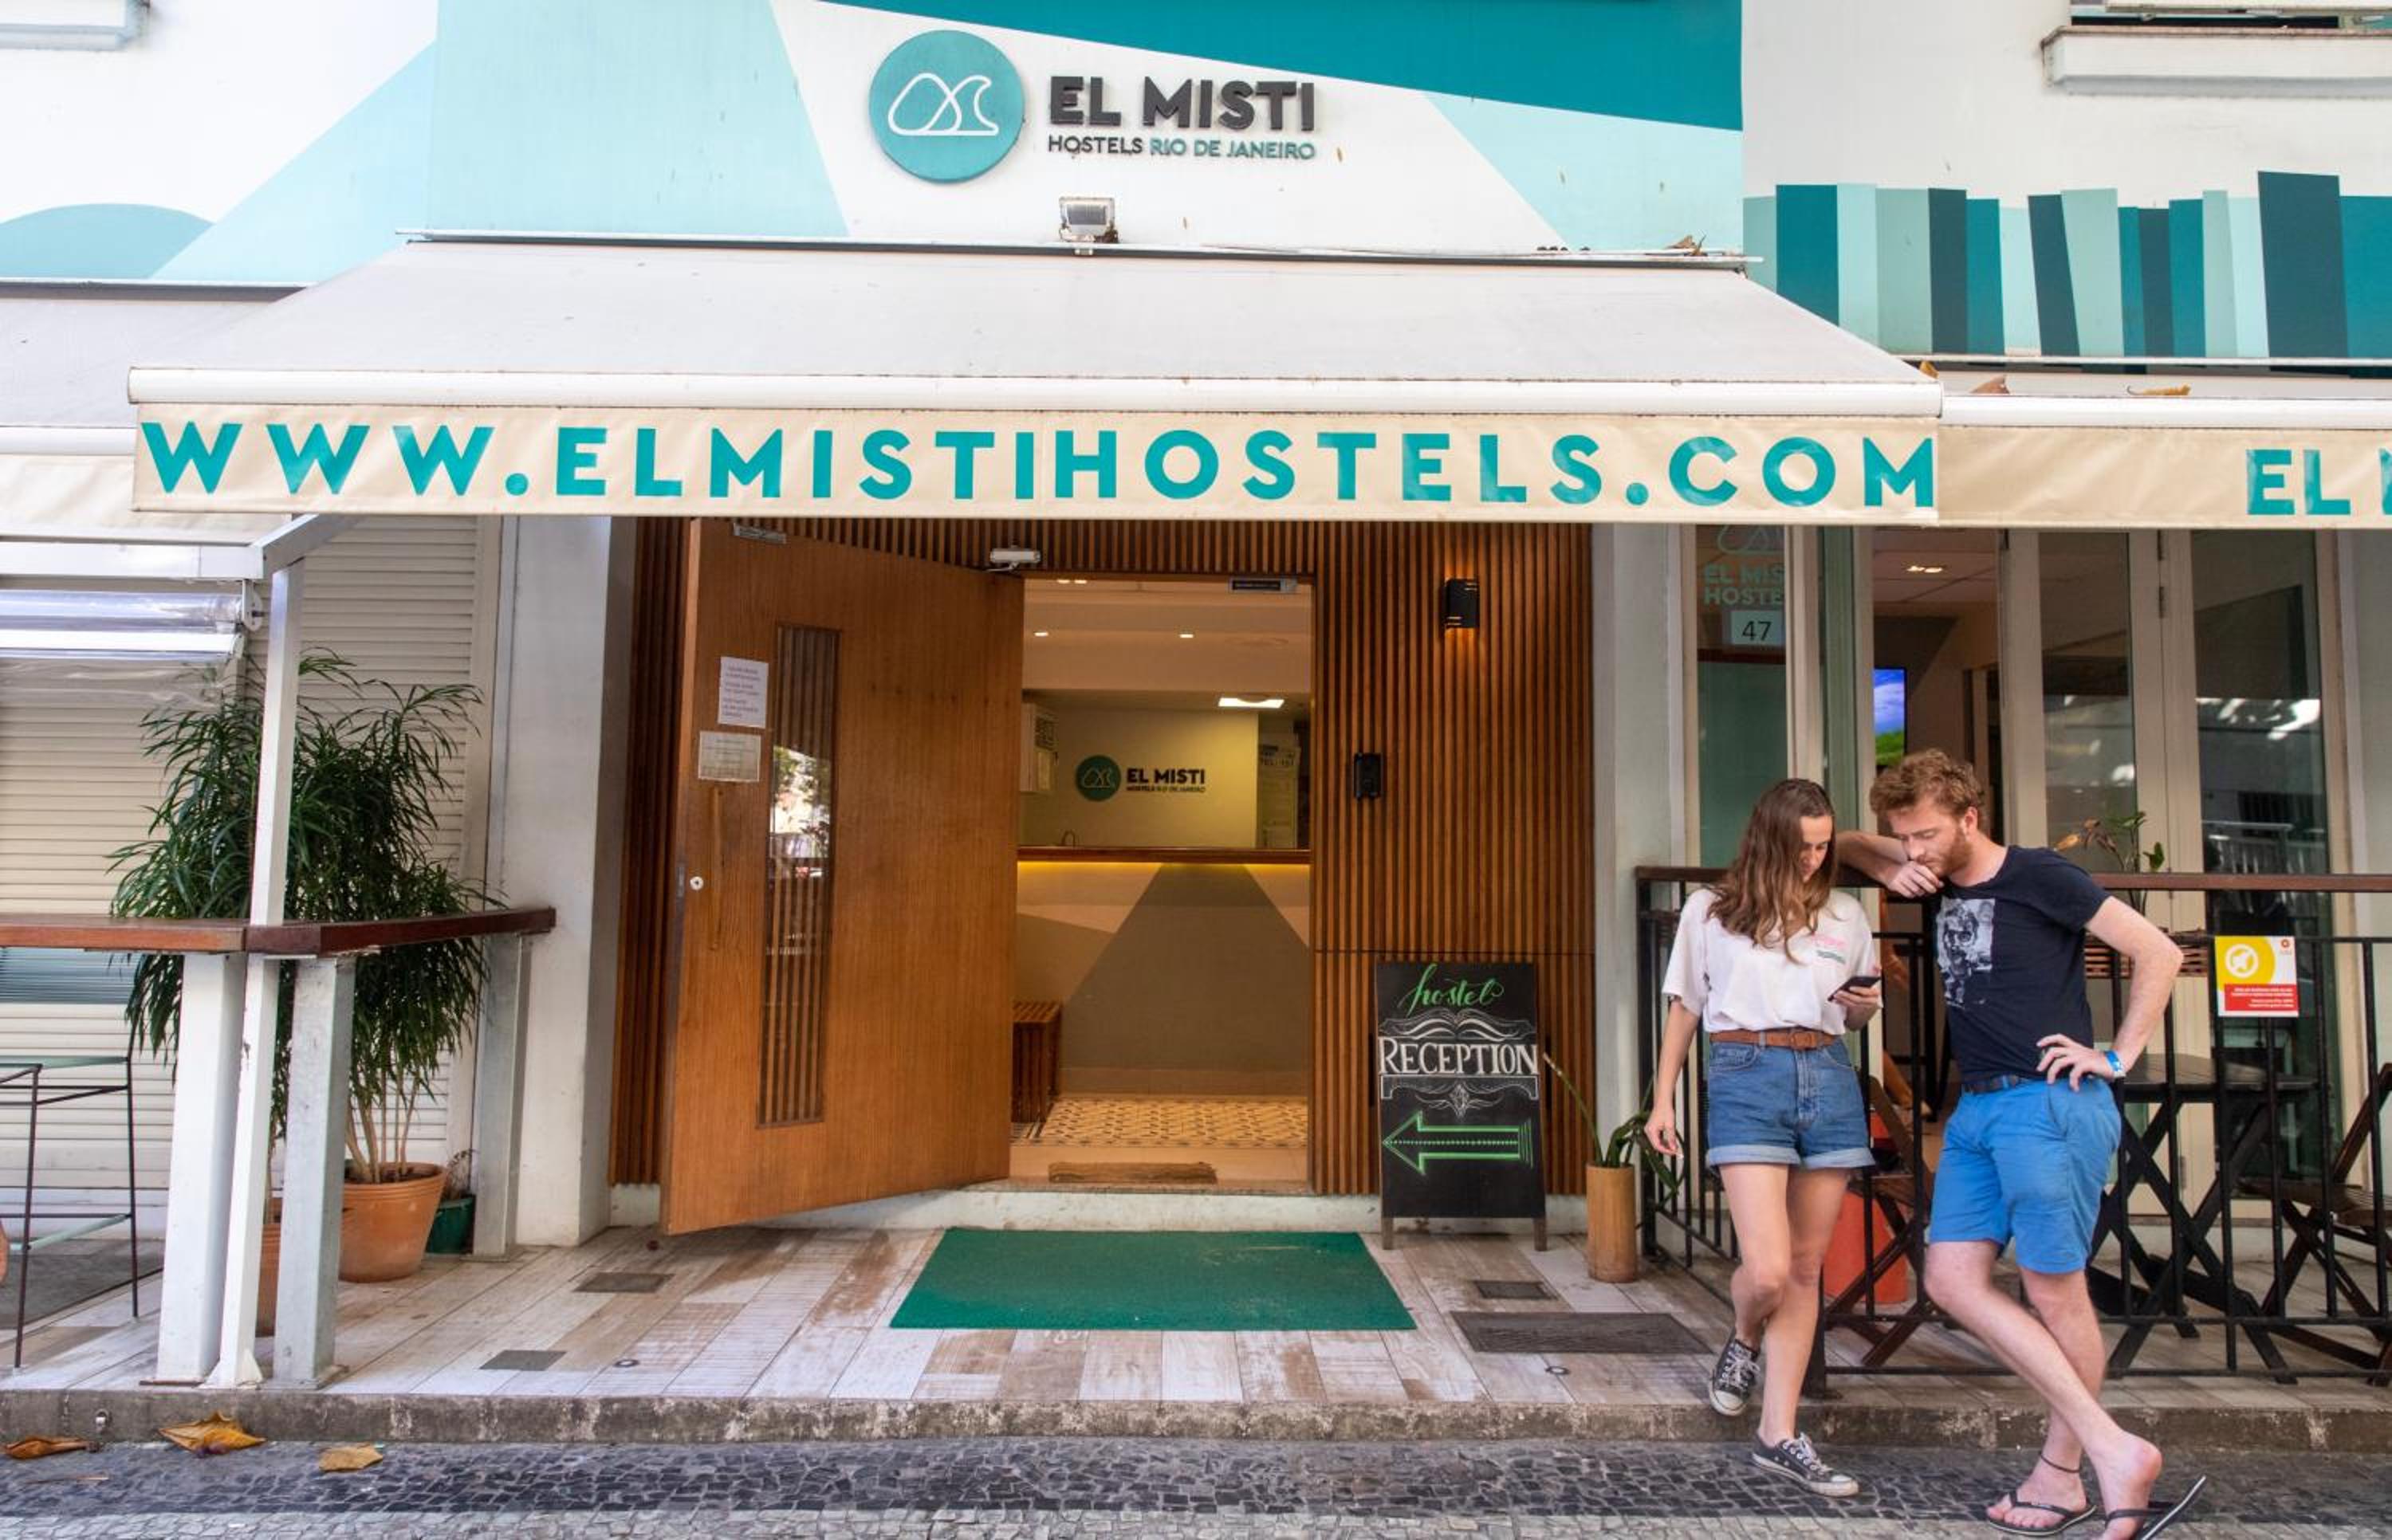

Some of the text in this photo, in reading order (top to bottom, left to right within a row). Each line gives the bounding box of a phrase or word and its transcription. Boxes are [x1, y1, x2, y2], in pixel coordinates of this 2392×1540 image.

[1050, 76, 1316, 132] EL MISTI
[1048, 136, 1316, 159] HOSTELS RIO DE JANEIRO
[140, 421, 1934, 508] WWW.ELMISTIHOSTELS.COM
[2246, 449, 2352, 516] EL
[1705, 564, 1733, 583] EL
[1741, 619, 1772, 641] 47
[1127, 768, 1206, 784] EL MISTI
[1398, 963, 1505, 1016] hostel
[1378, 1035, 1539, 1075] RECEPTION
